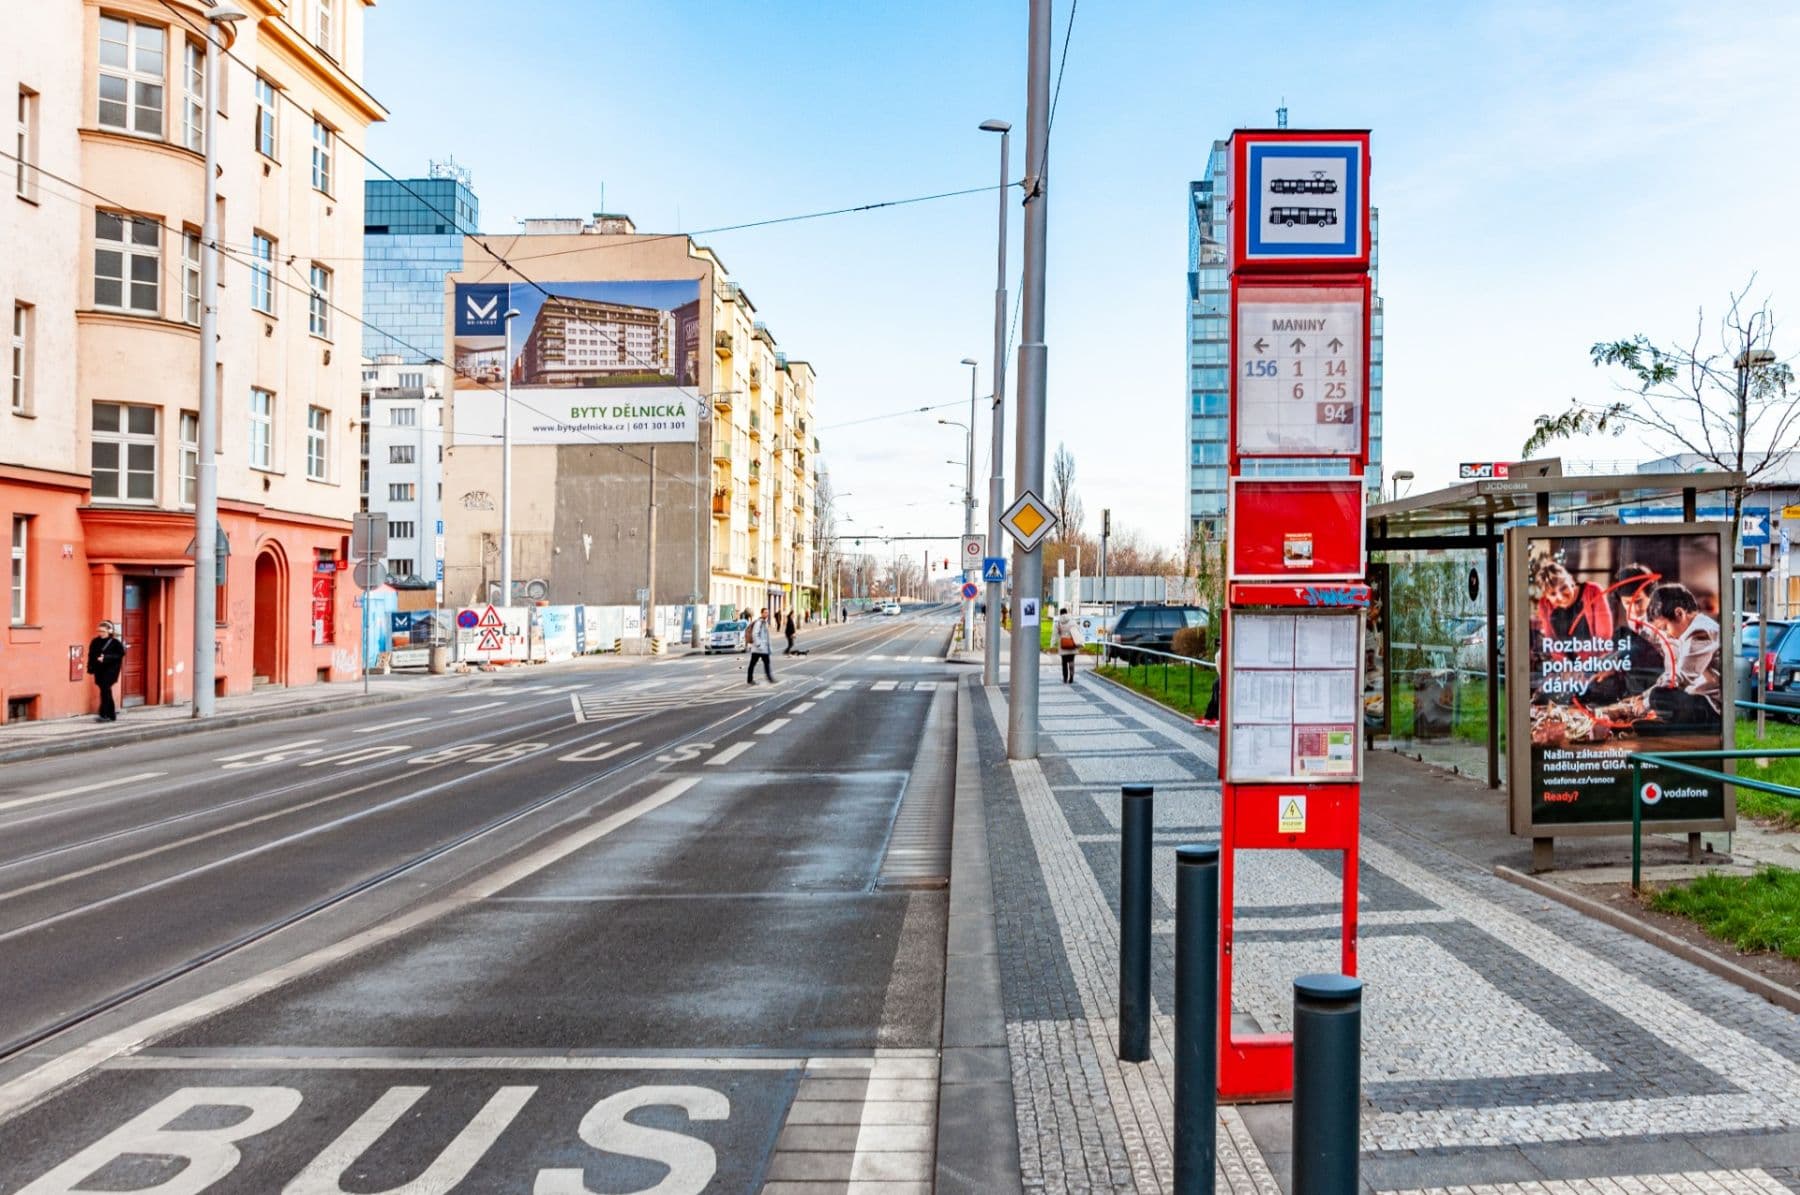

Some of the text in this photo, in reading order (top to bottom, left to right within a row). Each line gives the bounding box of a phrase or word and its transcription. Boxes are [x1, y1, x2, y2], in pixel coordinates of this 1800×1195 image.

[1272, 319, 1327, 332] MANINY
[1245, 360, 1347, 377] 156 1 14
[1293, 382, 1346, 399] 6 25
[571, 402, 686, 419] BYTY DĚLNICKÁ
[1324, 404, 1346, 422] 94
[532, 421, 686, 433] www.bytydelnicka.cz 601 301 301
[1486, 482, 1529, 491] JCDecaux
[1542, 635, 1632, 653] Rozbalte si
[1542, 655, 1632, 677] pohádkové
[1542, 677, 1590, 696] dárky
[1543, 760, 1600, 772] nadělujeme
[1601, 759, 1627, 771] GIGA
[1543, 790, 1580, 804] Ready?
[1663, 787, 1709, 799] vodafone
[12, 1084, 731, 1195] BUS
